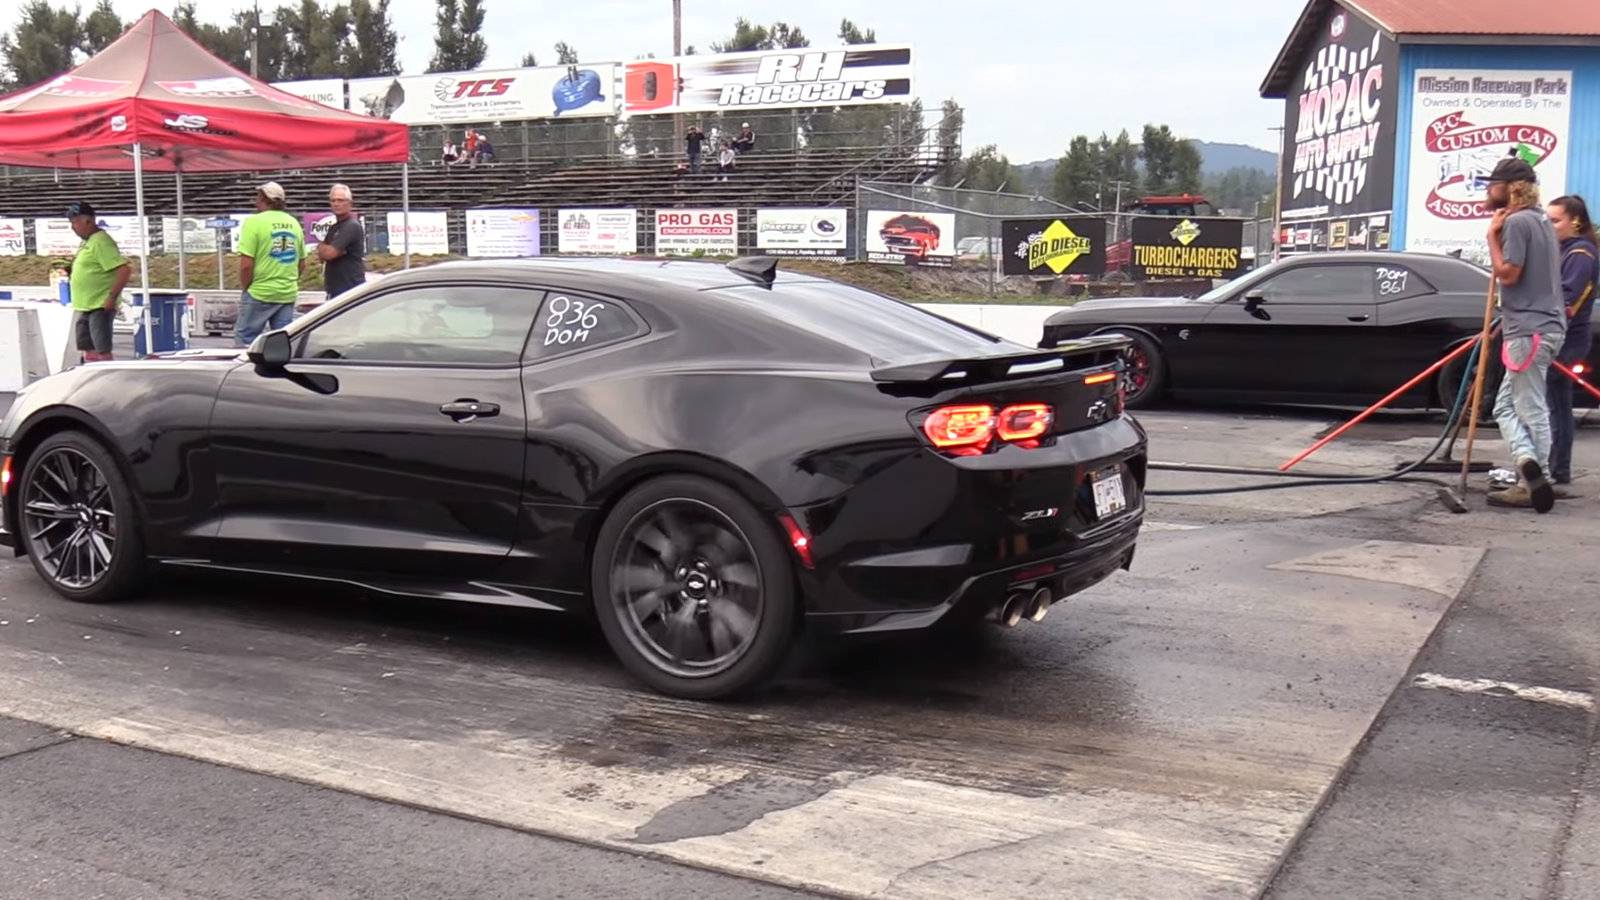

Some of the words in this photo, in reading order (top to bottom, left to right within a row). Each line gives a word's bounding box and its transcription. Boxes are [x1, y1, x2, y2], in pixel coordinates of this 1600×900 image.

[755, 51, 848, 84] RH
[452, 77, 516, 99] TCS
[718, 79, 887, 106] Racecars
[1418, 76, 1470, 93] Mission
[1471, 77, 1532, 97] Raceway
[1533, 78, 1567, 95] Park
[1295, 64, 1383, 143] MOPAC
[1423, 98, 1460, 108] Owned
[1462, 98, 1470, 107] &
[1473, 98, 1522, 110] Operated
[1525, 98, 1539, 109] By
[1542, 99, 1562, 109] The
[1293, 137, 1326, 174] AUTO
[1326, 121, 1381, 167] SUPPLY
[1436, 128, 1510, 151] CUSTOM
[1517, 128, 1556, 151] CAR
[658, 213, 691, 225] PRO
[699, 213, 734, 225] GAS
[1427, 199, 1494, 217] ASSOC
[1031, 241, 1048, 260] BD
[1051, 237, 1091, 253] DIESEL
[1134, 246, 1238, 269] TURBOCHARGERS
[1145, 266, 1186, 276] DIESEL
[1197, 268, 1223, 277] GAS
[547, 296, 604, 329] 836
[544, 328, 590, 346] DOM
